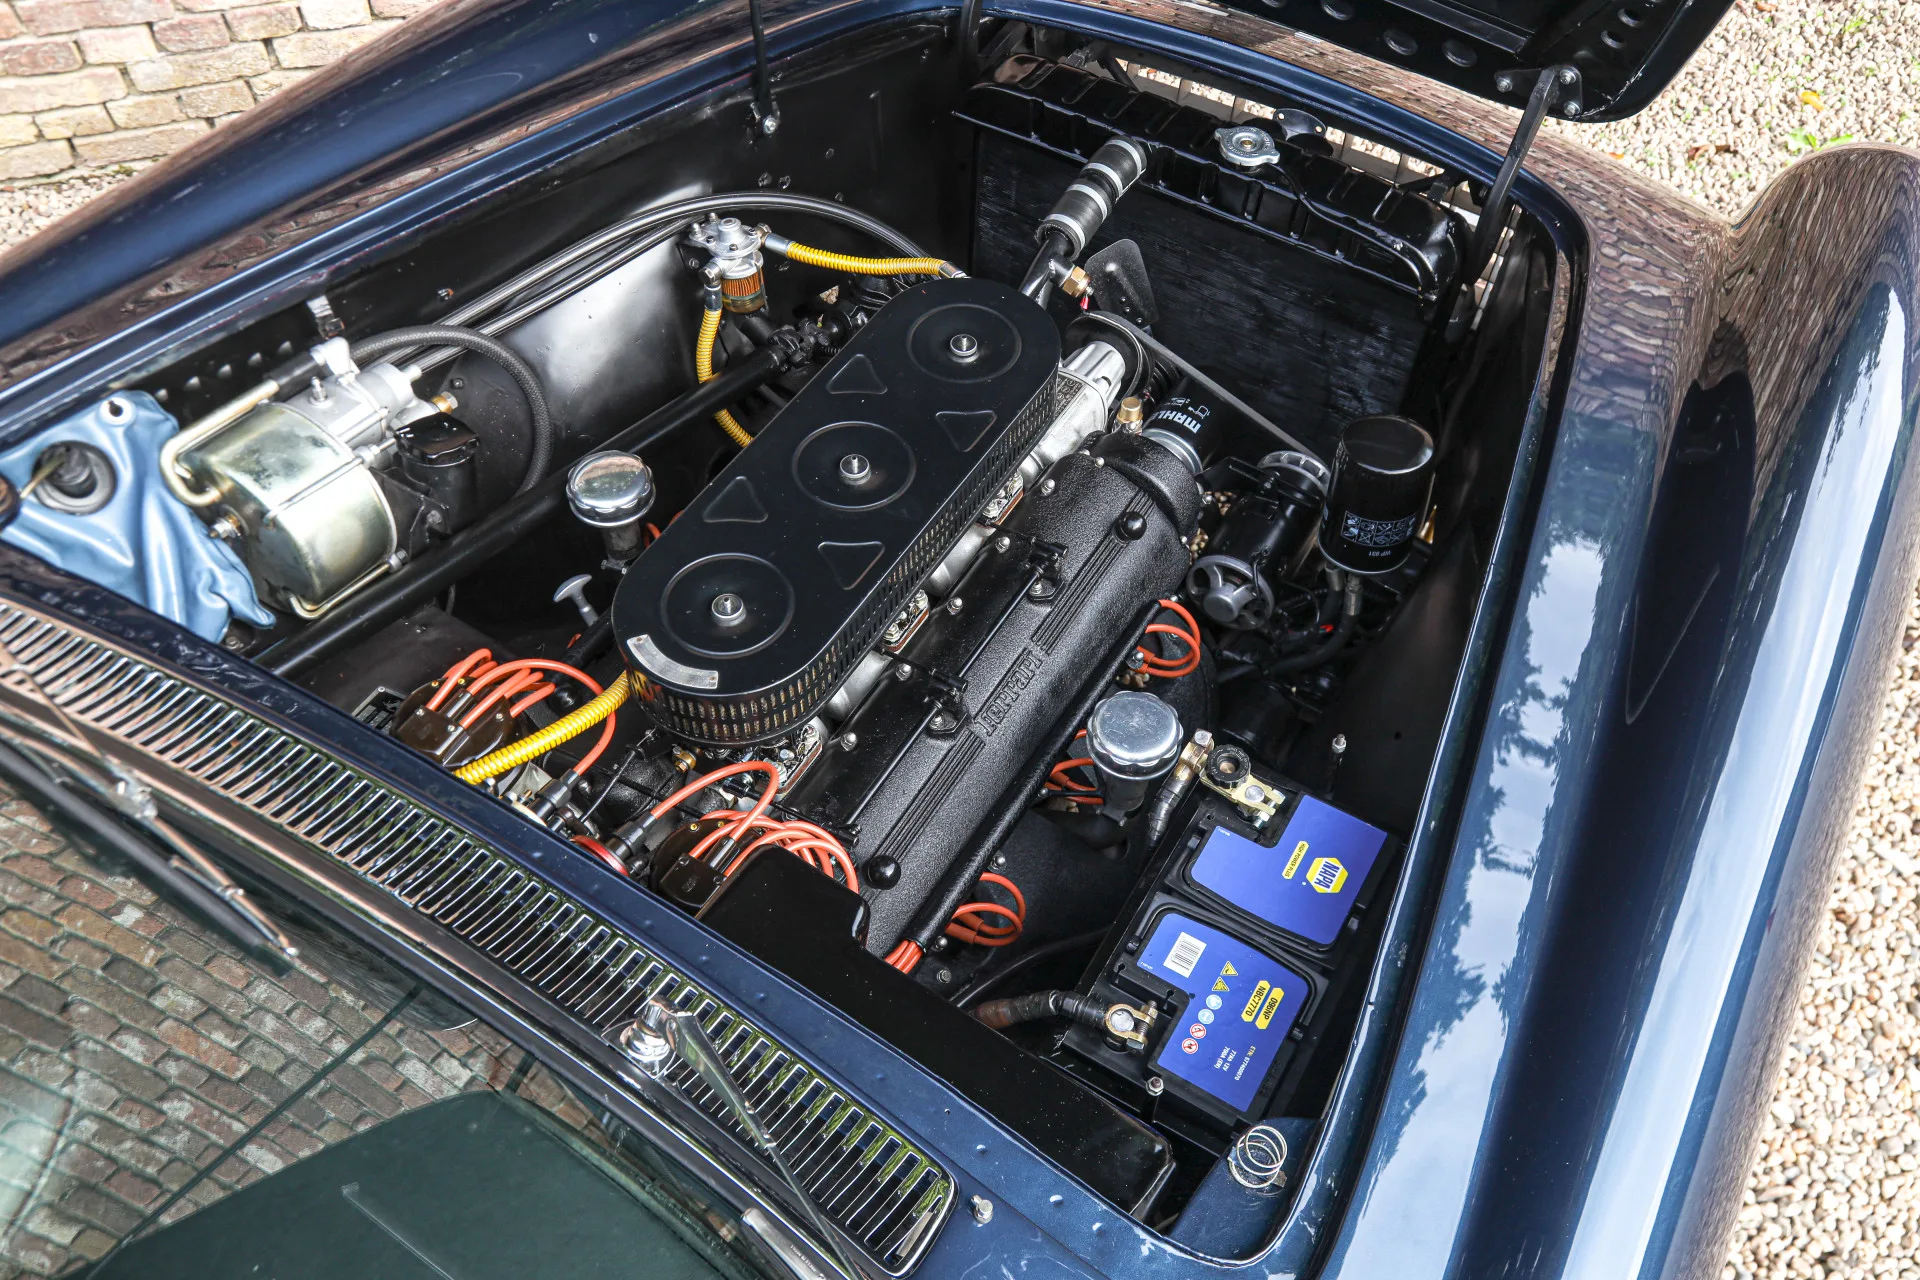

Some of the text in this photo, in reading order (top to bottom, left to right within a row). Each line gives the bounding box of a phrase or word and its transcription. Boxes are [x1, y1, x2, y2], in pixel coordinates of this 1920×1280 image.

[1284, 843, 1306, 878] HIGH POWER PLUS
[1314, 861, 1341, 889] NAPA
[1245, 985, 1267, 1017] NBC7770
[1262, 997, 1278, 1020] 096NP
